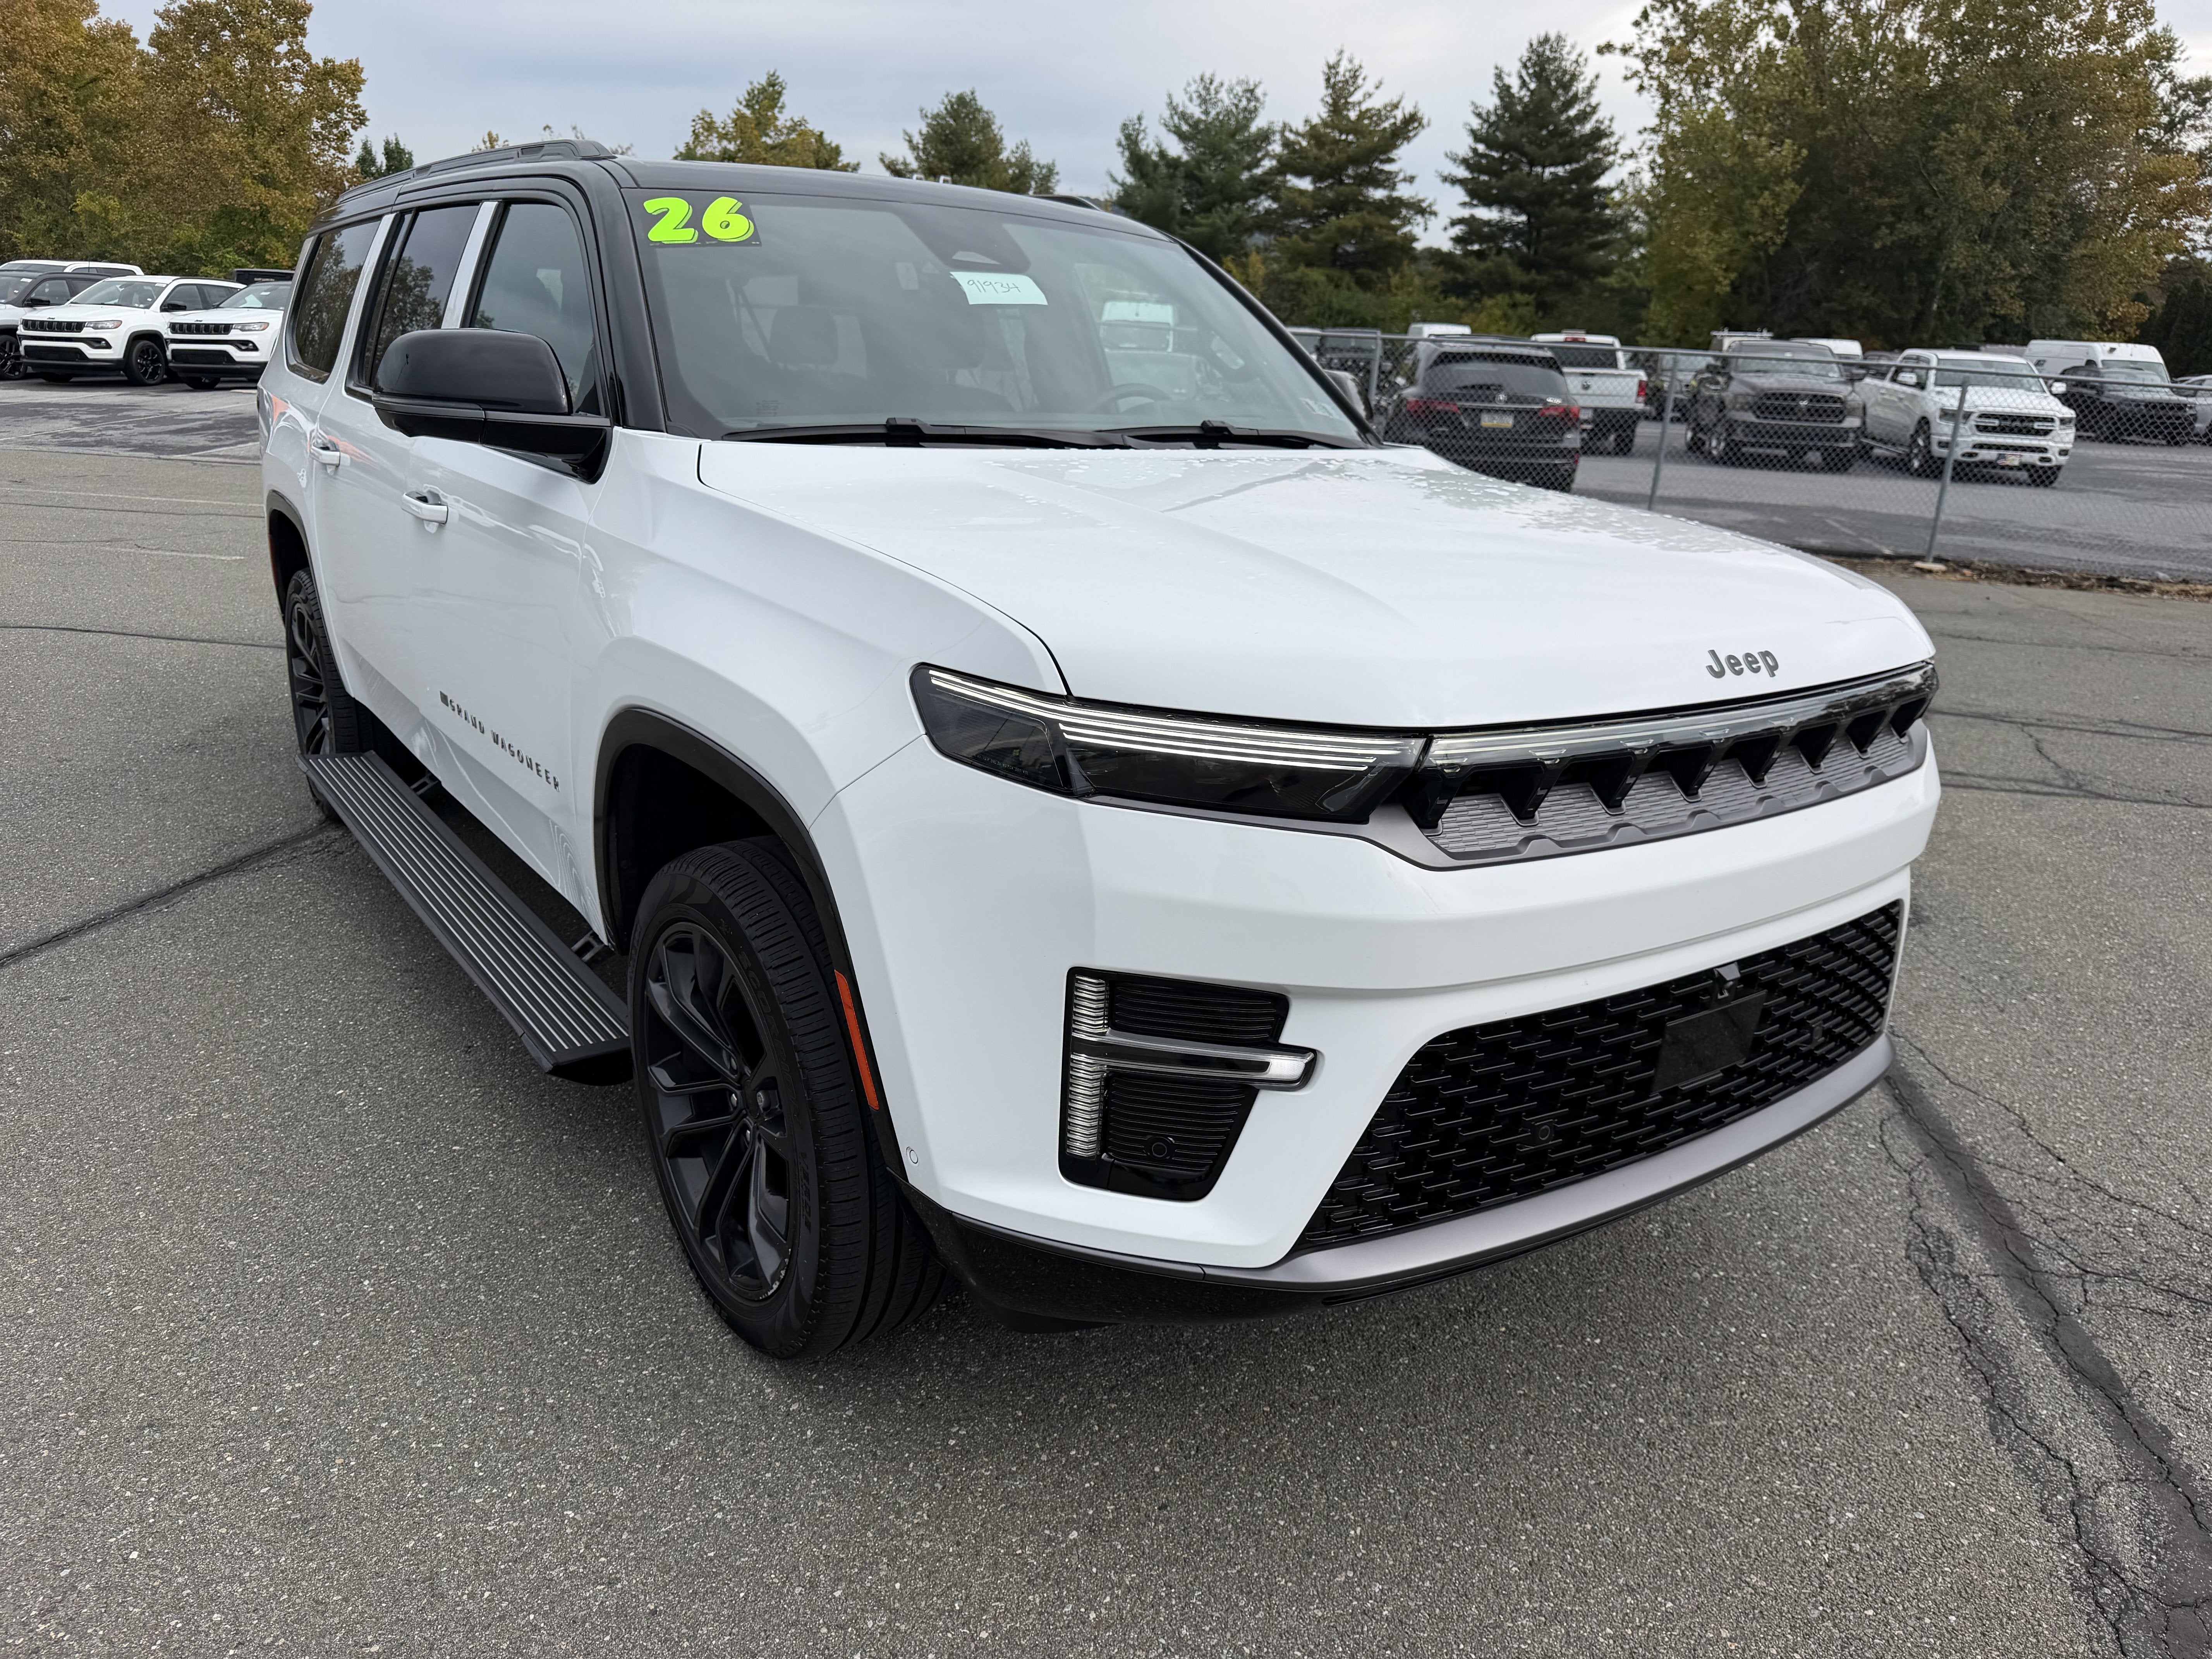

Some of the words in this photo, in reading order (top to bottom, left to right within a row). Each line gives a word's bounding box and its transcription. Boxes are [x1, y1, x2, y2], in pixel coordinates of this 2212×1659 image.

[643, 196, 754, 244] 26
[967, 279, 1021, 294] 91934
[1705, 649, 1779, 679] Jeep
[449, 699, 485, 734] GRAND
[490, 730, 560, 793] WAGONEER
